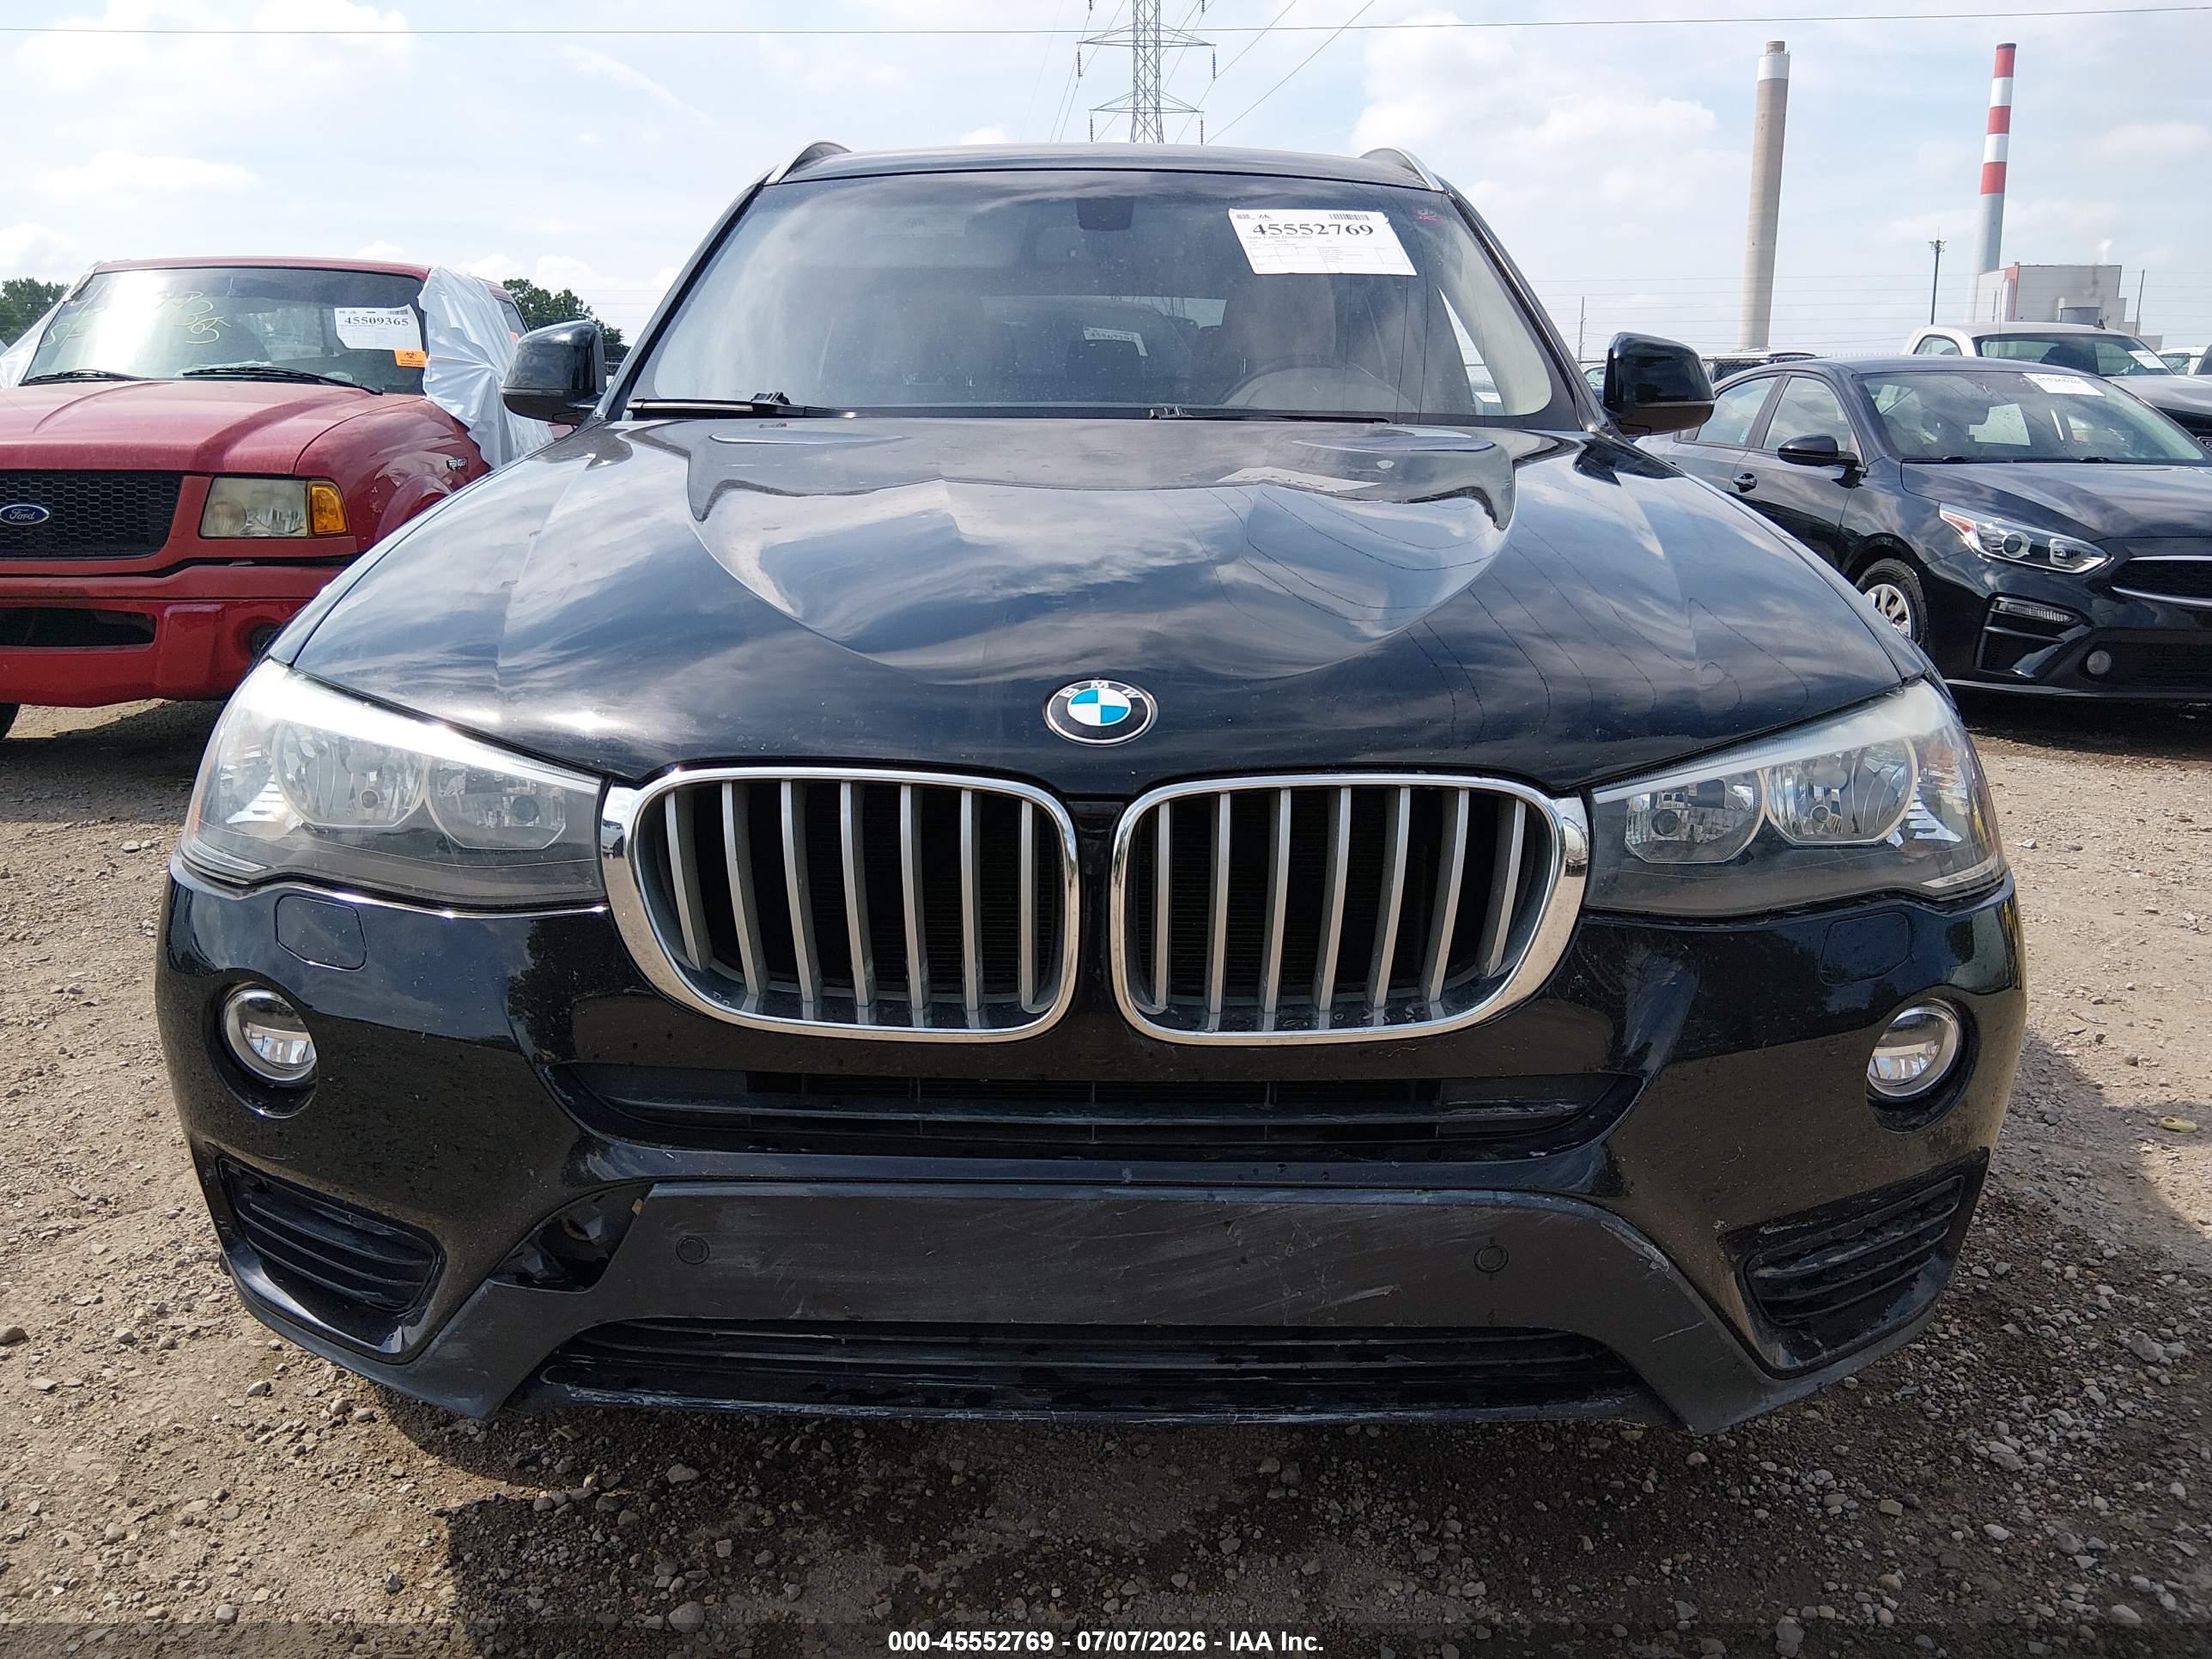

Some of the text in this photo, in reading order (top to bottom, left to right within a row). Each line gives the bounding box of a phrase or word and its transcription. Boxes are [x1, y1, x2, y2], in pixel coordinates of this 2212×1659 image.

[1253, 223, 1374, 236] 45552769
[344, 316, 410, 326] 45509365
[9, 508, 35, 520] Ford
[1058, 681, 1141, 698] BMW
